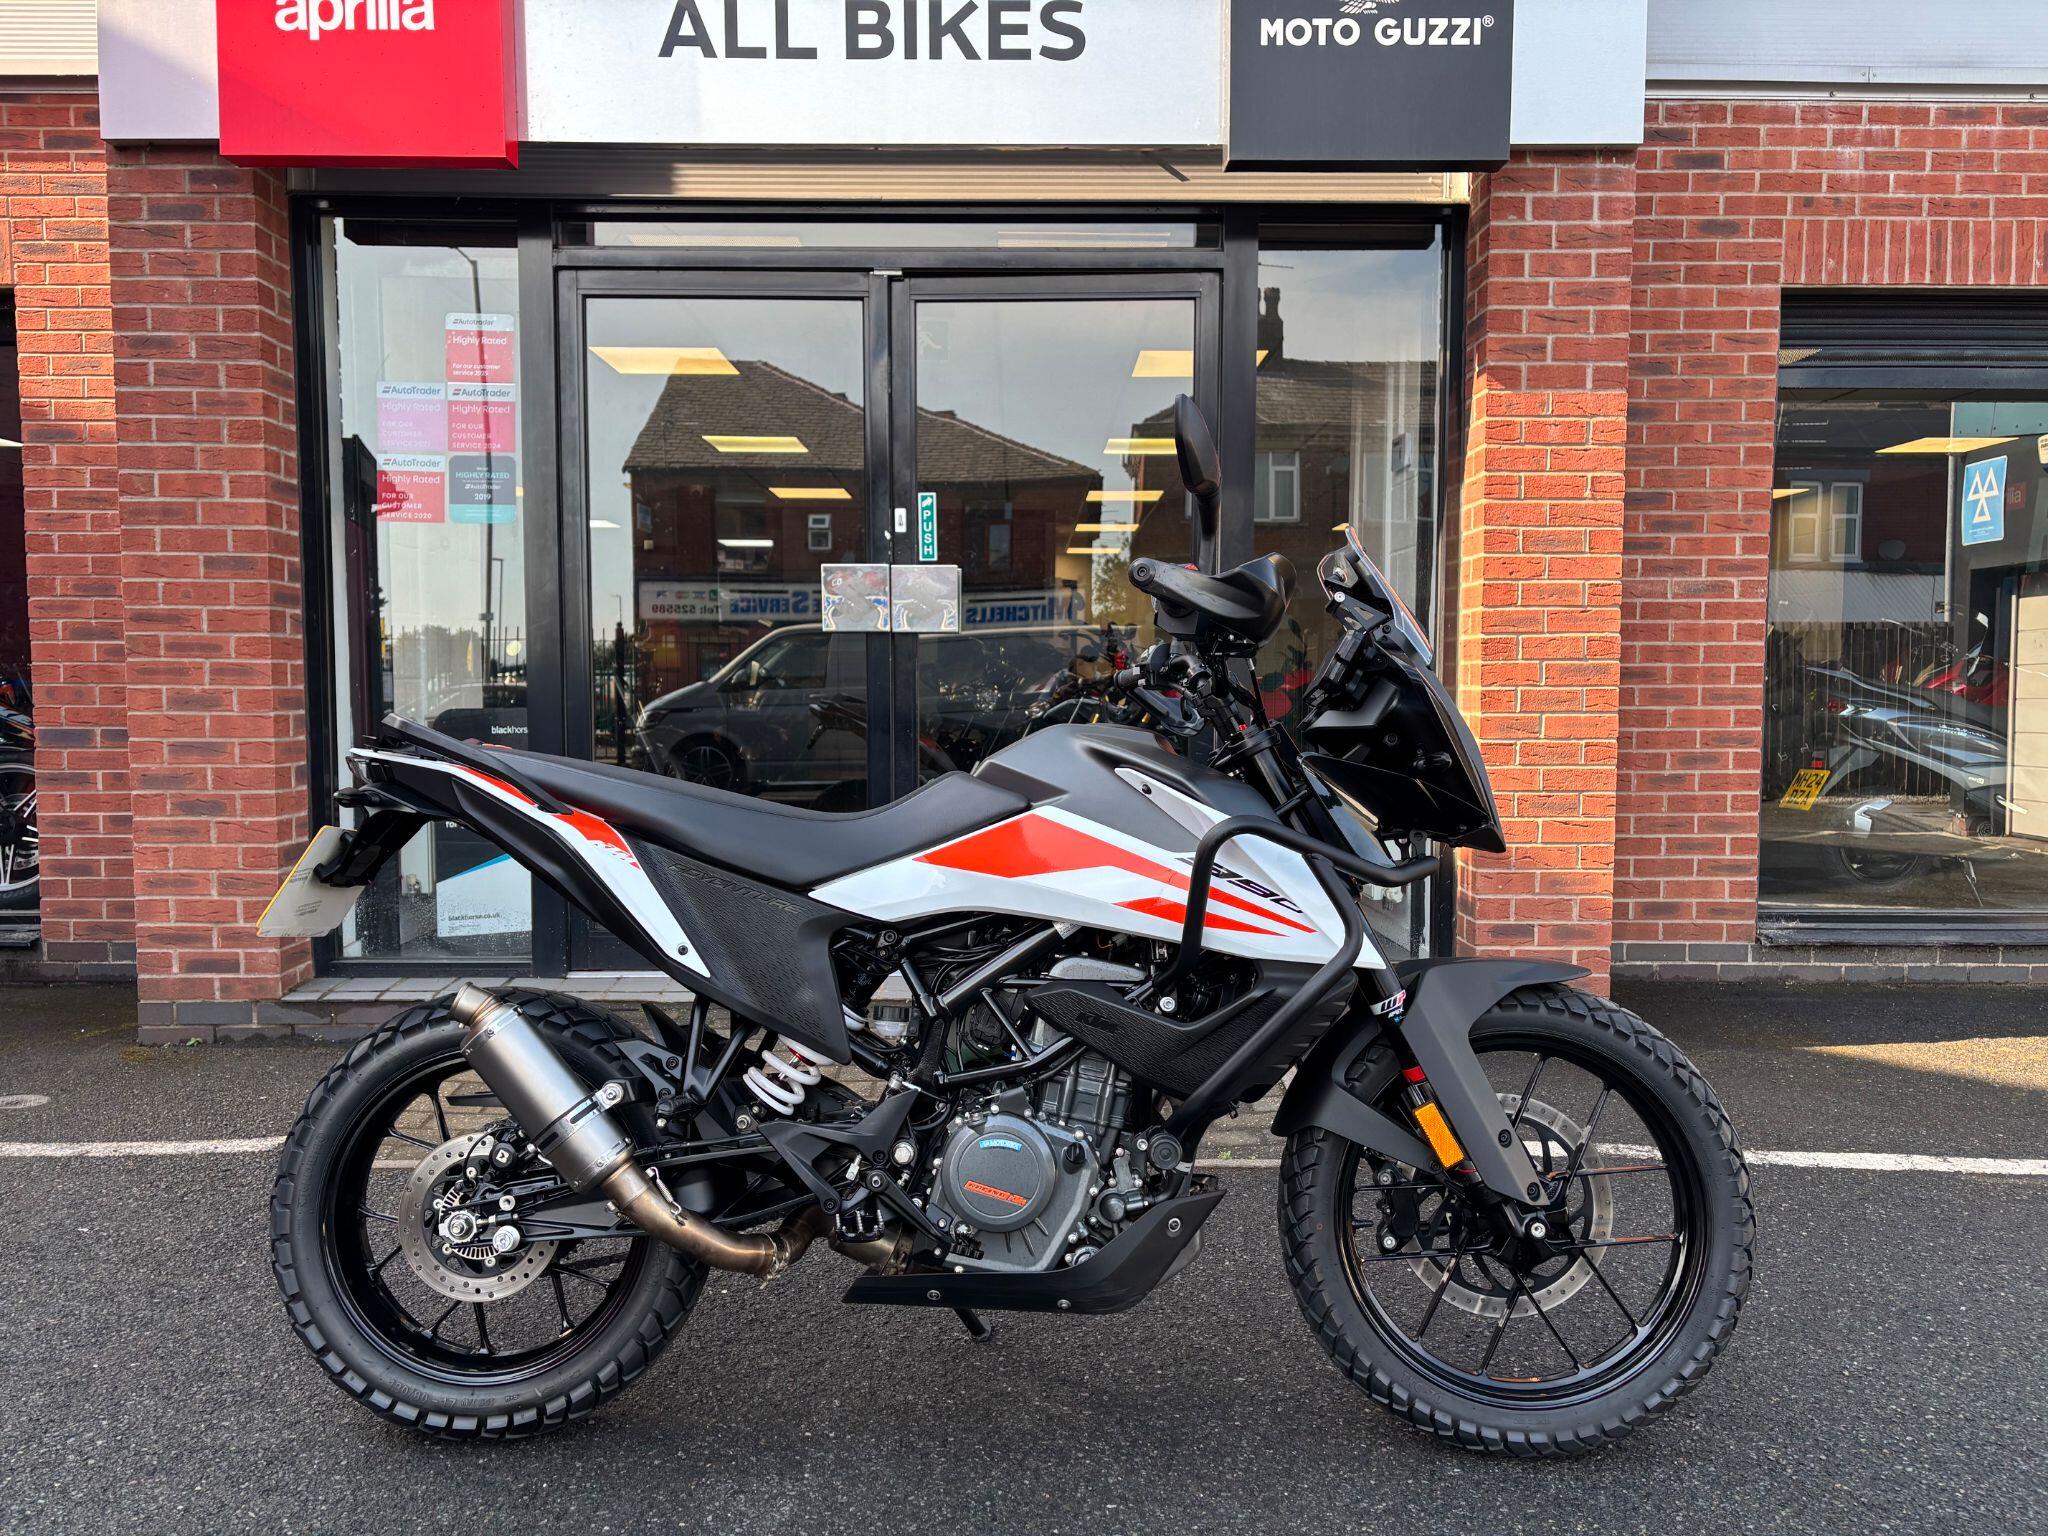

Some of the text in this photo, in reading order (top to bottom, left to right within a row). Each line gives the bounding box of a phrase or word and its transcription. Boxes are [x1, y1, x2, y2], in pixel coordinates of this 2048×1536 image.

[274, 0, 435, 41] aprilia
[658, 0, 1086, 61] ALL BIKES
[1260, 18, 1361, 46] MOTO
[452, 336, 507, 346] Highly Rated
[391, 386, 441, 396] AutoTrader
[460, 388, 511, 398] AutoTrader
[452, 404, 510, 415] Highly Rated
[391, 458, 441, 469] AutoTrader
[382, 474, 440, 485] Highly Rated
[455, 472, 510, 480] HIGHLY RATED
[382, 492, 414, 500] FOR OUR
[474, 492, 492, 501] 2019
[382, 502, 422, 510] CUSTOMER
[414, 512, 432, 520] 2020
[923, 509, 933, 556] PUSH
[491, 725, 528, 734] blackhors
